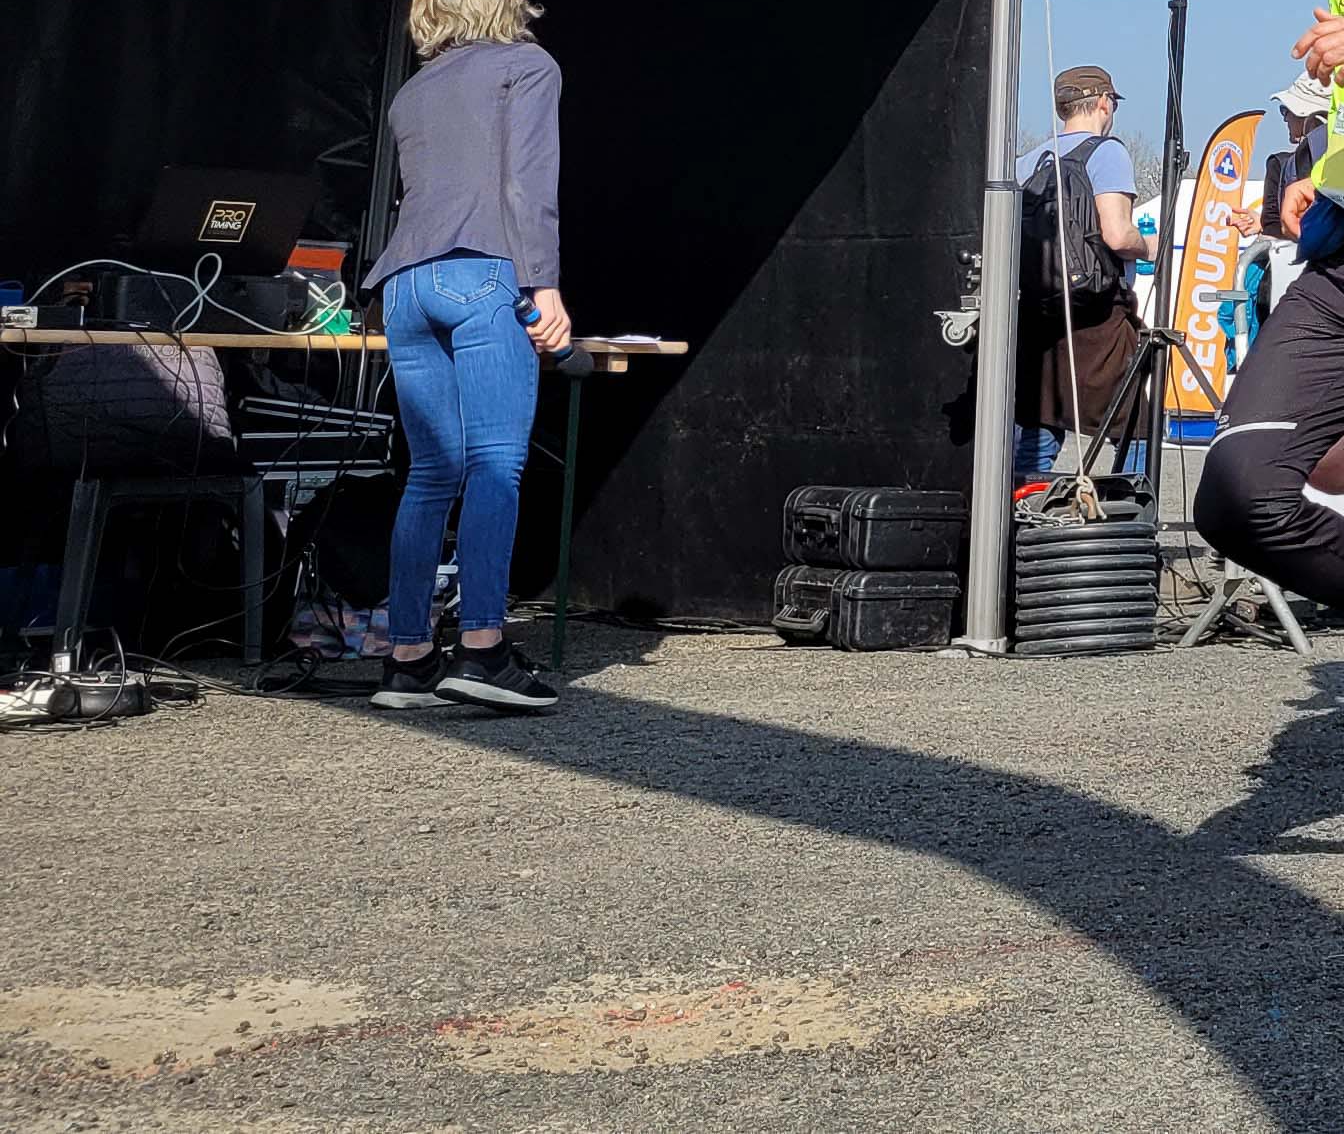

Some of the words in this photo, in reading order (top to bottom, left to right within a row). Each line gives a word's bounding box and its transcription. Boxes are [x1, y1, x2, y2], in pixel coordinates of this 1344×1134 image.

[213, 209, 246, 222] PRO
[210, 220, 242, 230] TIMING
[1181, 200, 1234, 395] SECOURS
